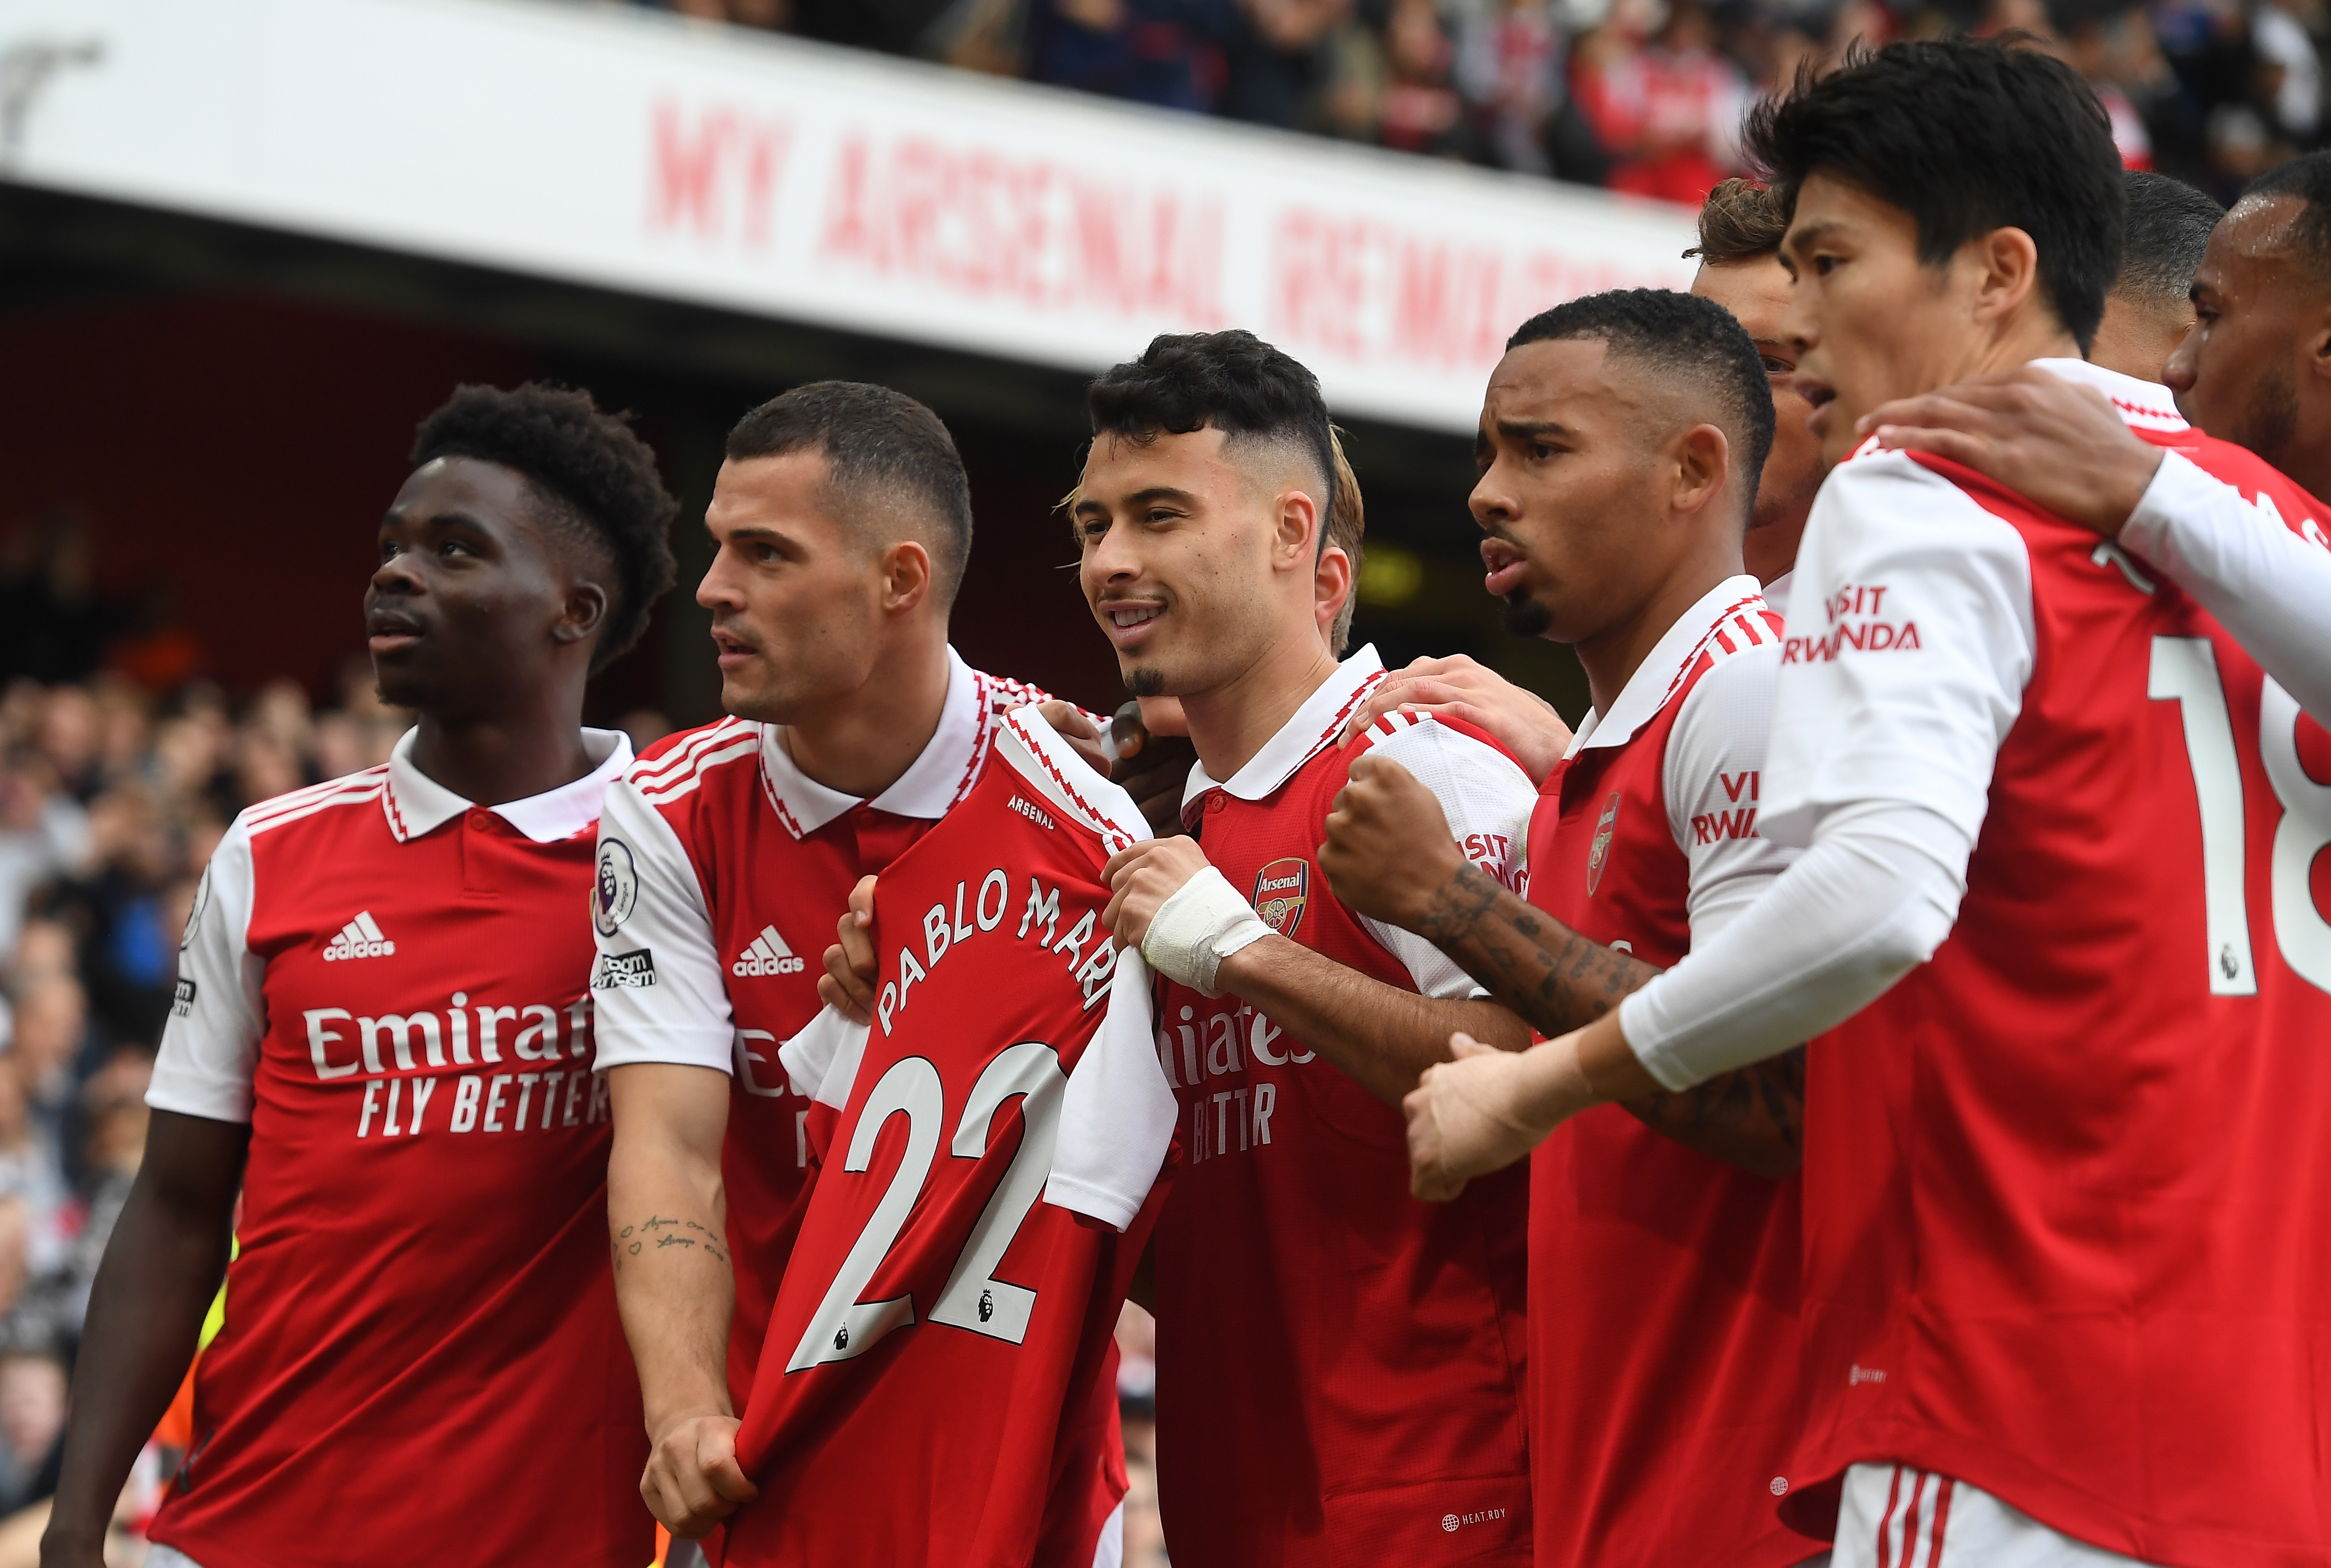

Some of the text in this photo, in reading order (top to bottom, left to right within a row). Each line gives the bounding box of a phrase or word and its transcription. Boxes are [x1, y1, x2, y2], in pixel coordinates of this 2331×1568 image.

[816, 129, 1227, 331] ARSENAL
[1007, 795, 1054, 831] ARSENAL
[1259, 871, 1300, 893] Arsenal
[323, 940, 395, 963] adidas
[732, 955, 805, 977] adidas
[876, 868, 1009, 1038] PABLO
[302, 991, 594, 1080] Emirat
[357, 1069, 609, 1139] FLY BETTER
[784, 1040, 1070, 1376] 22
[1461, 1508, 1505, 1525] HEAT.RDY
